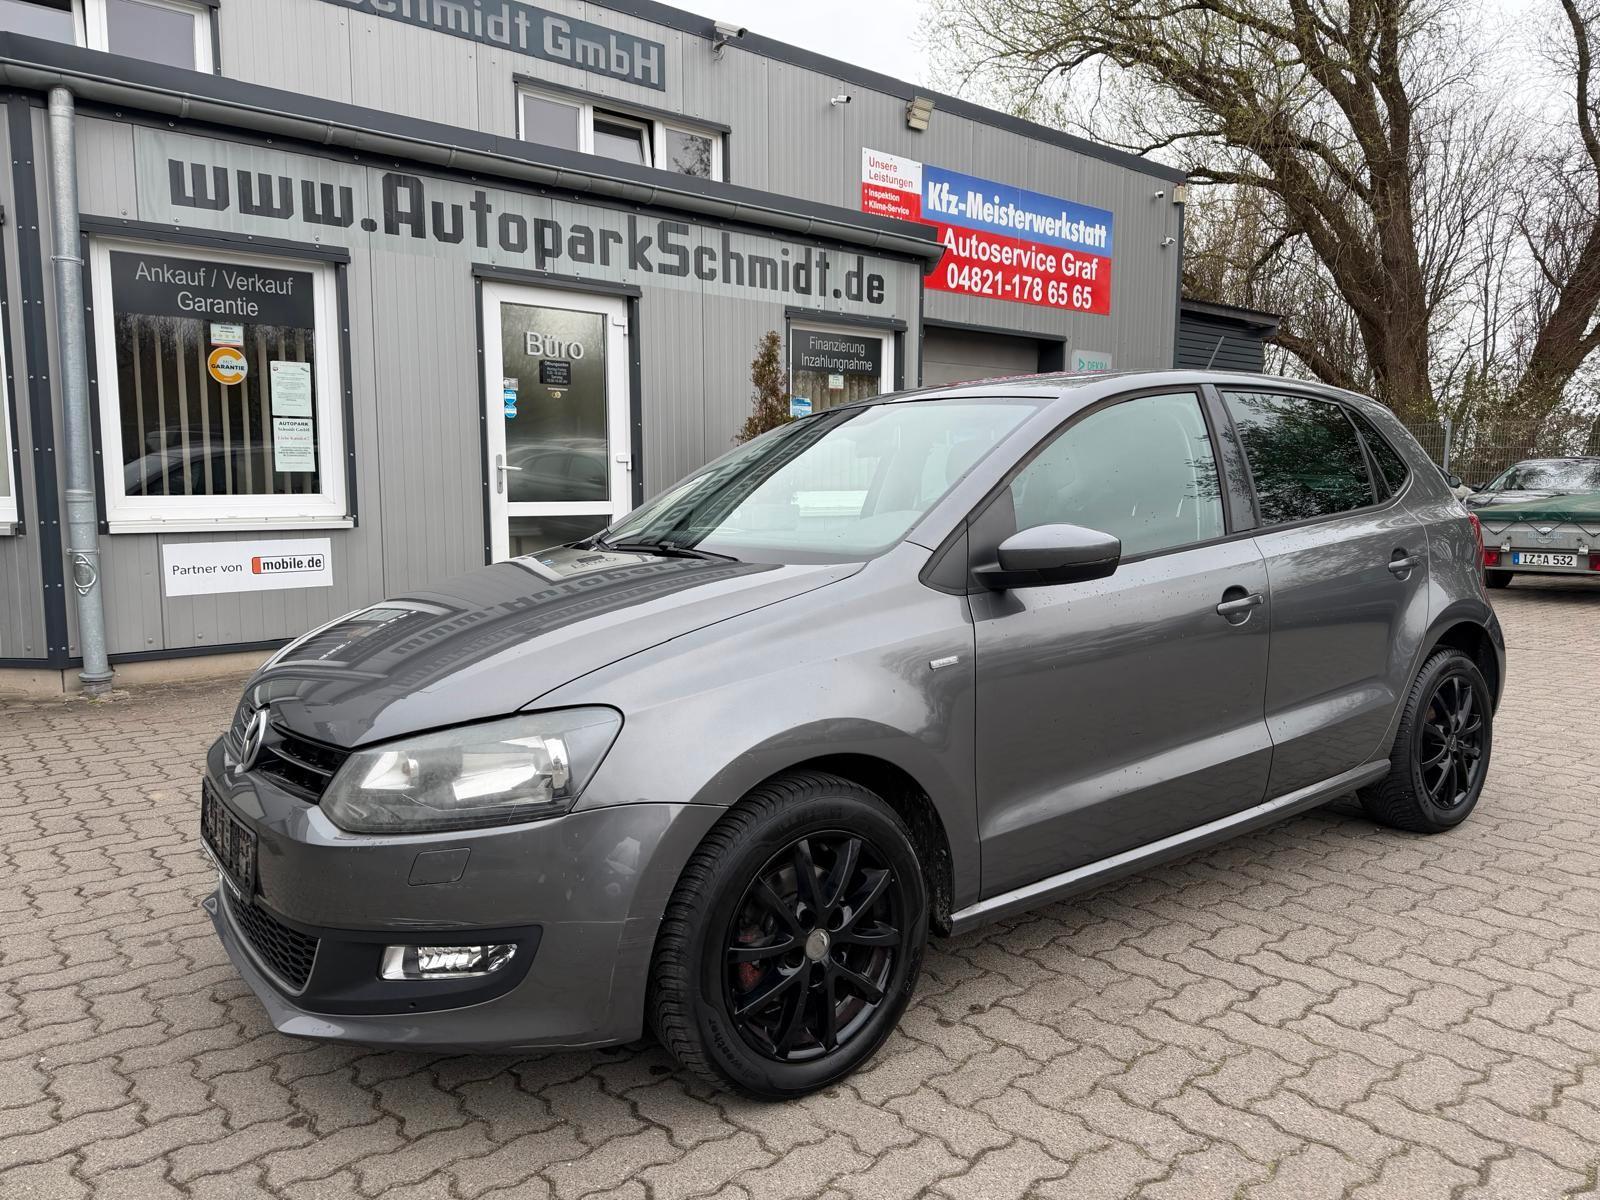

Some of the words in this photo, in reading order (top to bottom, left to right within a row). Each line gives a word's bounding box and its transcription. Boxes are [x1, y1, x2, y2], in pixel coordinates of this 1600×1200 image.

[340, 0, 530, 50] midt
[543, 15, 659, 85] GmbH
[868, 156, 898, 173] Unsere
[868, 170, 914, 189] Leistungen
[868, 188, 900, 203] Inspektion
[868, 200, 910, 216] Klima-Service
[928, 181, 1107, 248] Kfz-Meisterwerkstatt
[168, 158, 885, 304] www.AutoparkSchmidt.de
[943, 228, 1056, 274] Autoservice
[1061, 252, 1098, 281] Graf
[135, 261, 206, 288] Ankauf
[222, 270, 294, 296] Verkauf
[946, 263, 1043, 302] 04821-178
[1049, 280, 1070, 306] 65
[1072, 284, 1092, 309] 65
[177, 291, 259, 317] Garantie
[524, 331, 584, 360] Büro
[809, 336, 866, 357] Finanzierung
[211, 363, 246, 371] GARANTIE
[801, 353, 873, 372] Inzahlungnahme
[172, 564, 218, 576] Partner
[221, 564, 243, 573] von
[262, 556, 322, 571] mobile.de
[1522, 554, 1536, 565] IZ
[1542, 555, 1550, 565] A
[1552, 555, 1573, 566] 532
